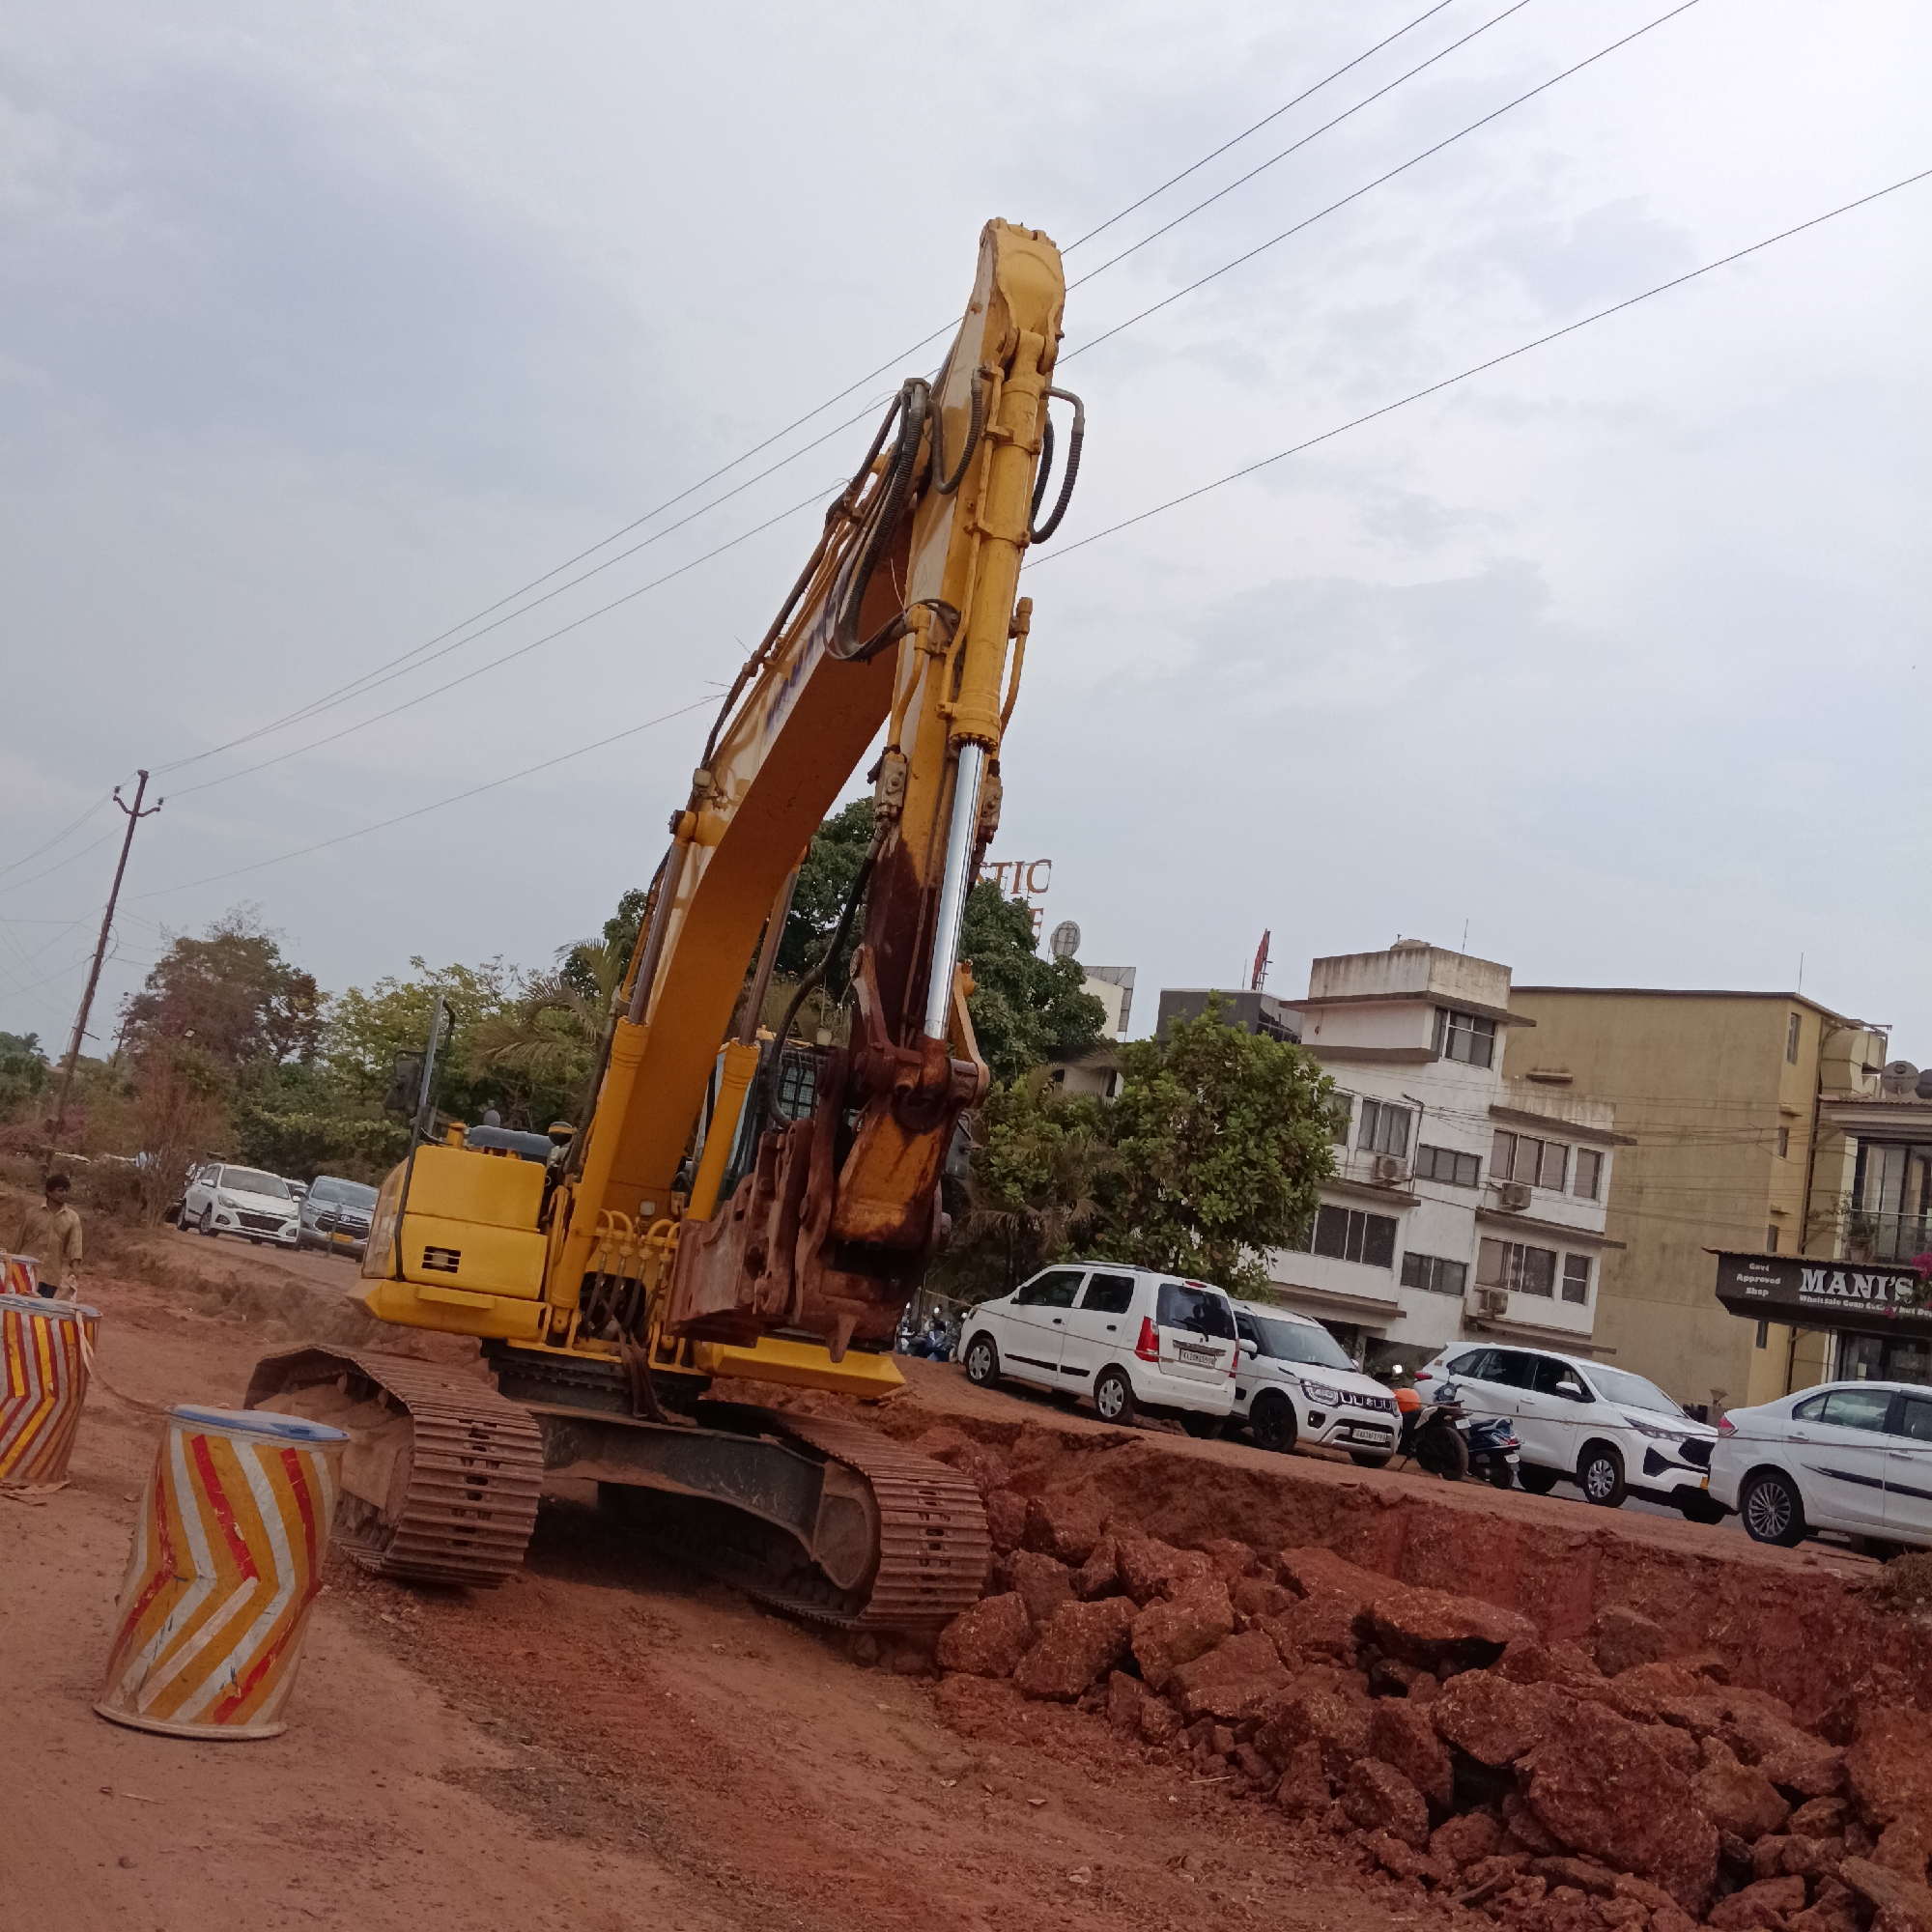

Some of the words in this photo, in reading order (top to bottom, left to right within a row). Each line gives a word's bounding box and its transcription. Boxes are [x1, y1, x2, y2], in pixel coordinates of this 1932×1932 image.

[1736, 1273, 1781, 1285] Approved
[1798, 1267, 1915, 1304] MANI'S
[1745, 1287, 1770, 1297] Shop
